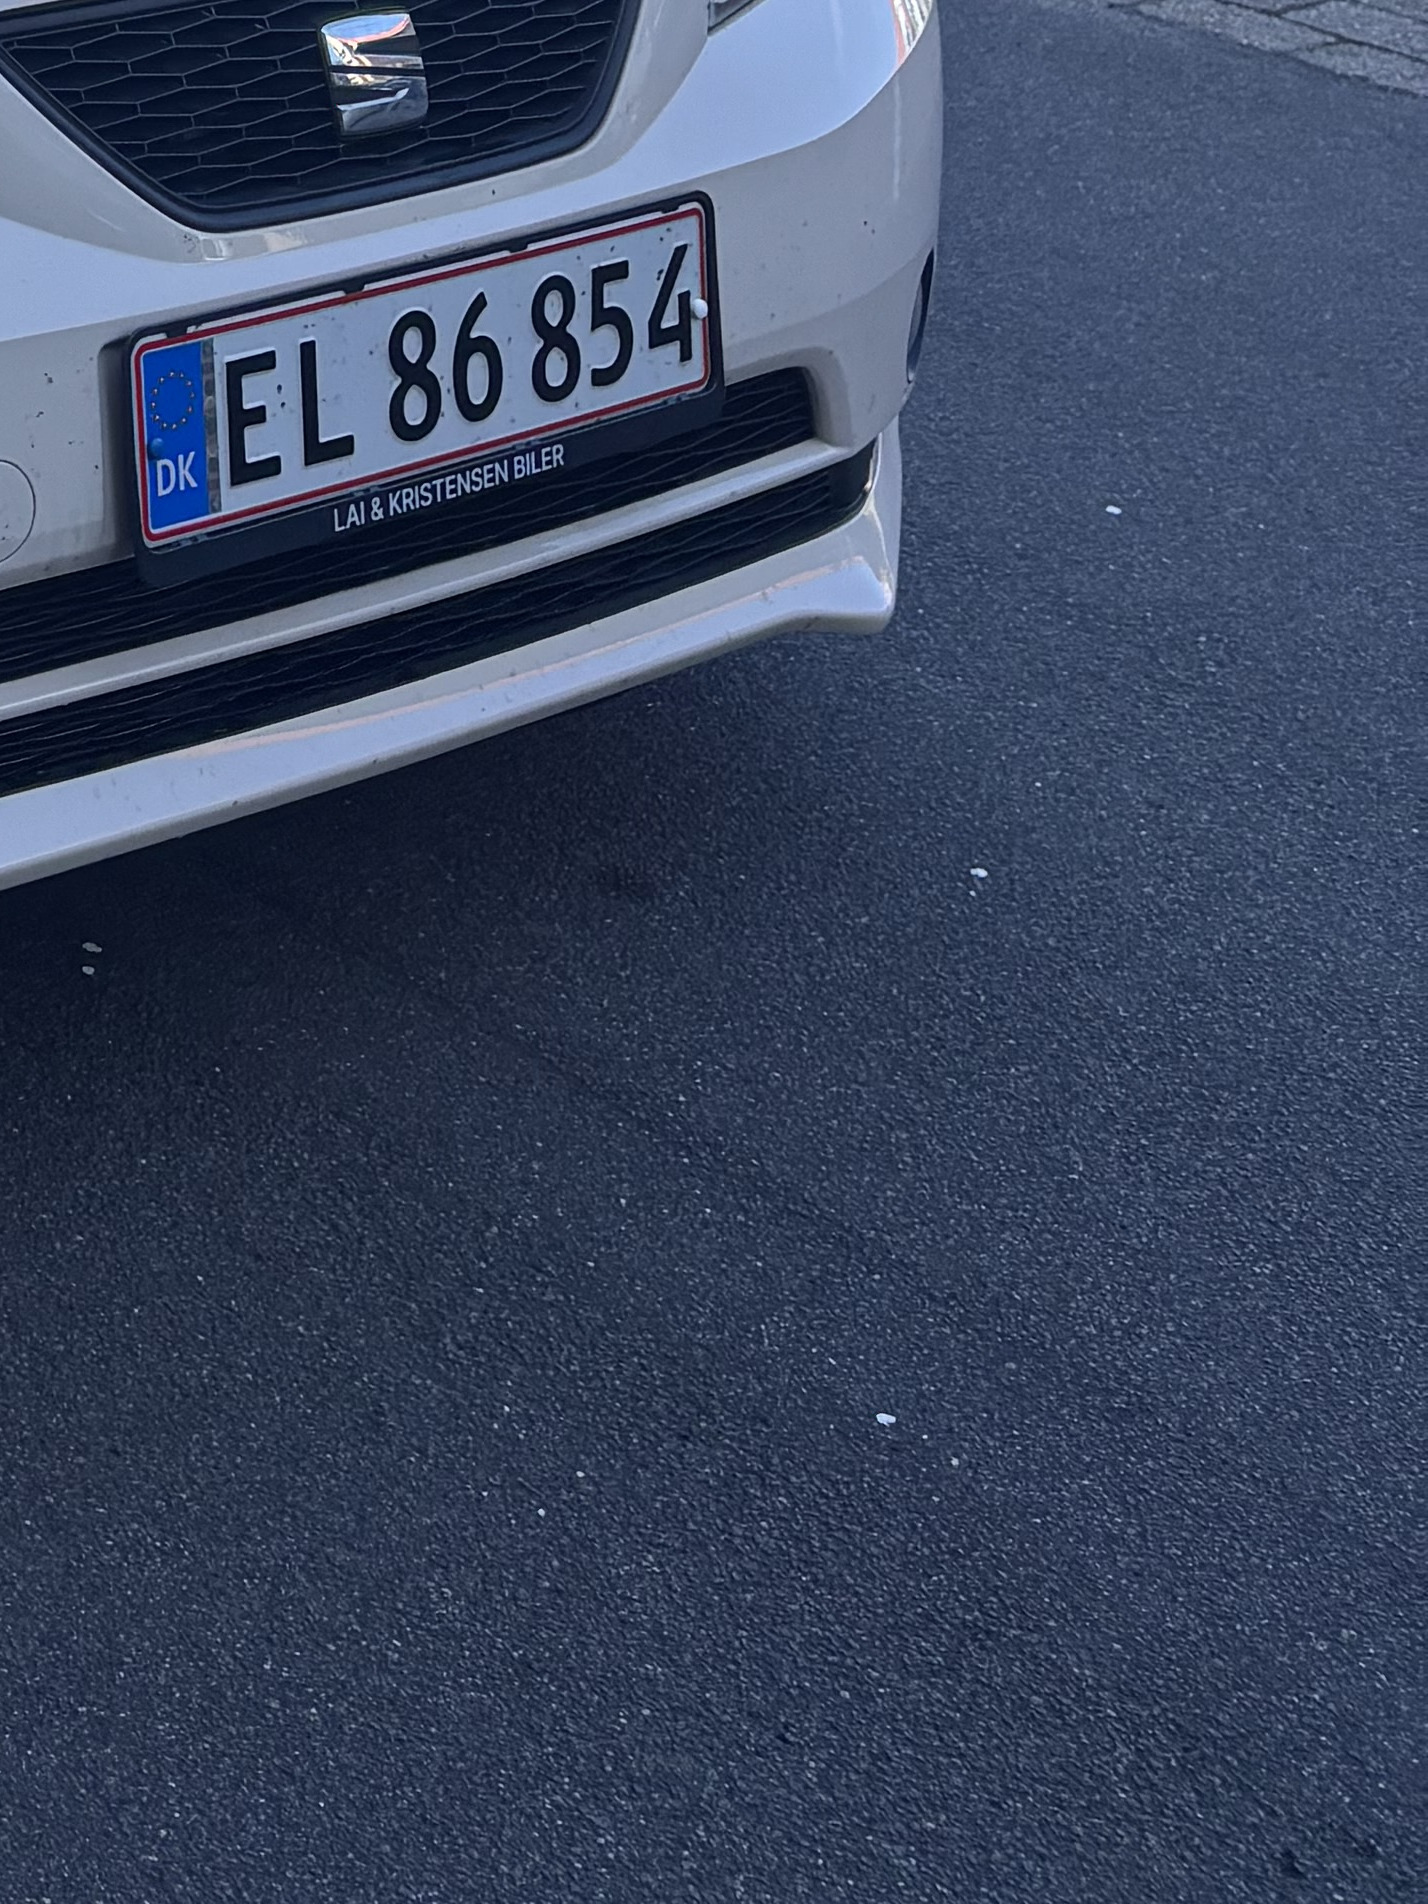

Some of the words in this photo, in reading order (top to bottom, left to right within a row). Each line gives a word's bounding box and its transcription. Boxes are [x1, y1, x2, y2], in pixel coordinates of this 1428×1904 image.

[156, 451, 199, 497] DK
[224, 339, 355, 487] EL
[387, 291, 503, 442] 86
[530, 243, 694, 403] 854
[333, 501, 366, 533] LAI
[370, 496, 385, 522] &
[388, 459, 509, 517] KRISTENSEN
[513, 443, 565, 480] BILER
